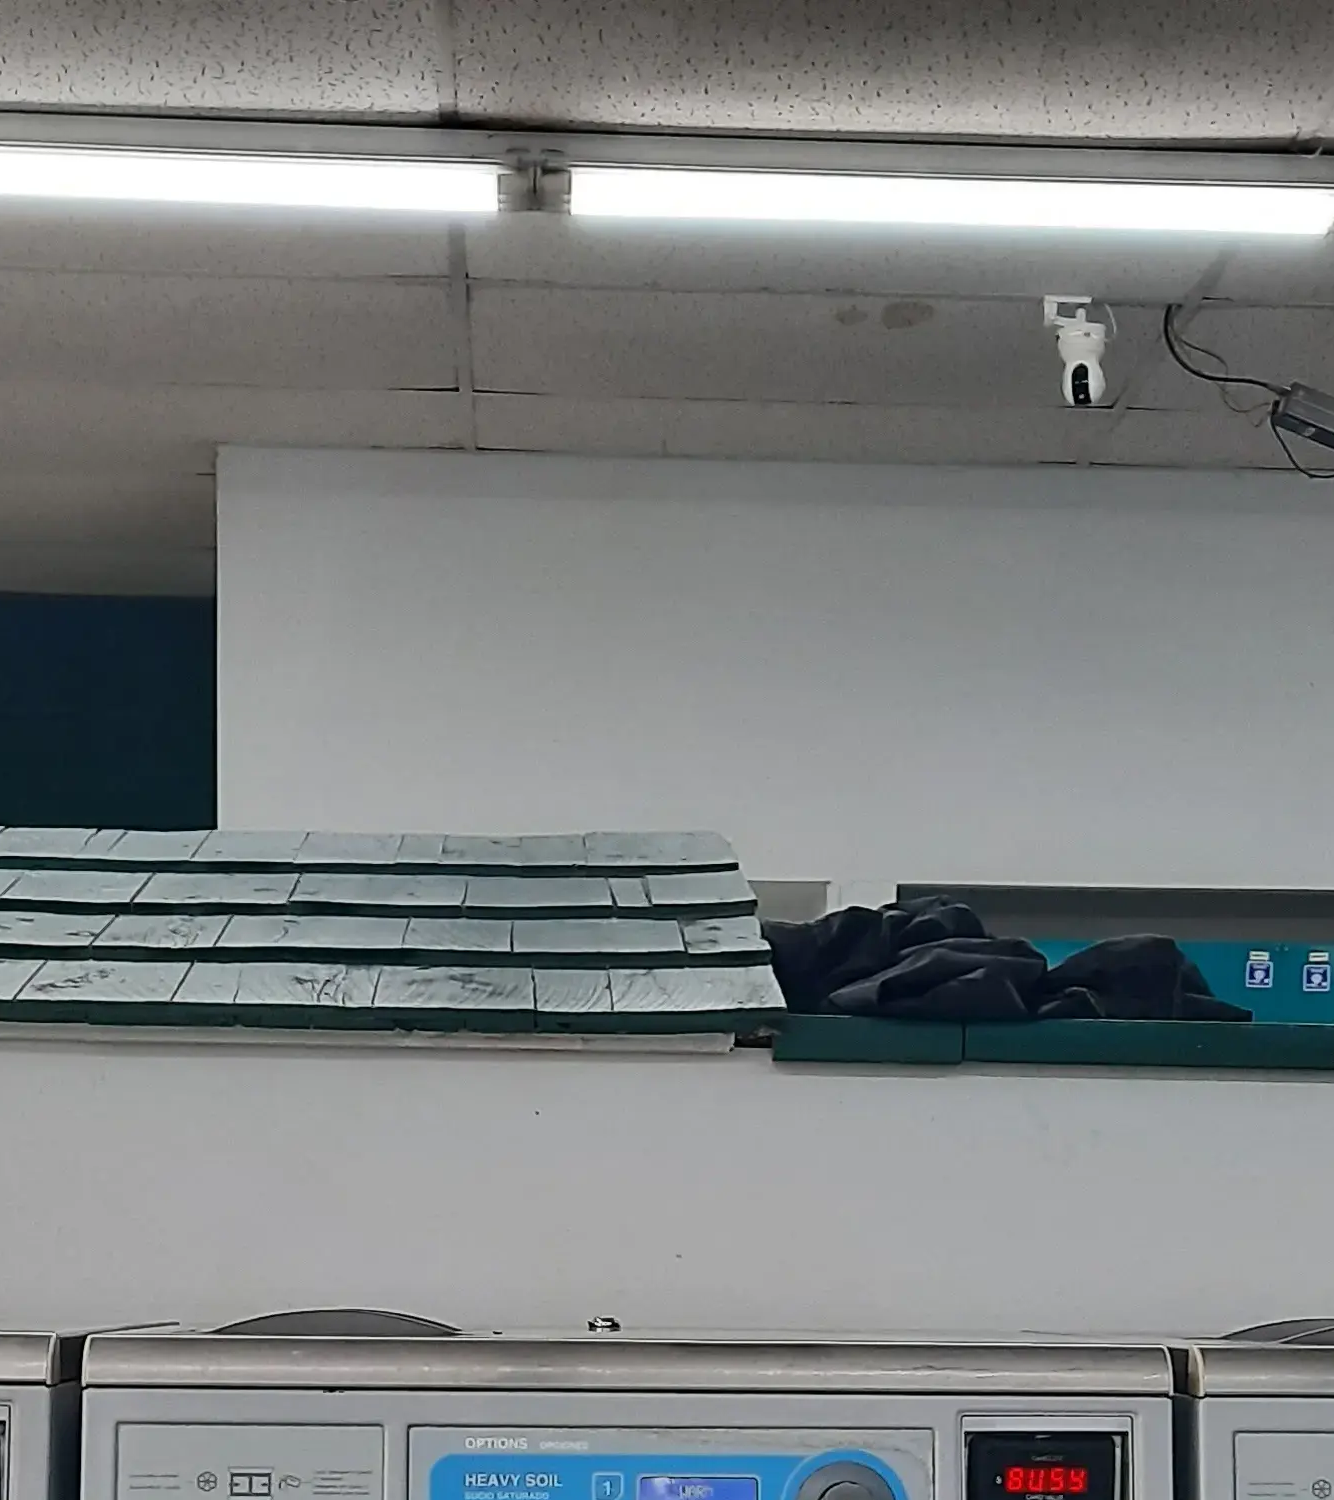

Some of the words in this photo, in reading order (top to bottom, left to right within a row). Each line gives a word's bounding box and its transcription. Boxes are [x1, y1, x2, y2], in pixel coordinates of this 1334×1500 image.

[465, 1437, 528, 1449] OPTIONS
[465, 1473, 521, 1487] HEAVY
[525, 1473, 563, 1487] SOIL
[602, 1480, 612, 1496] 1
